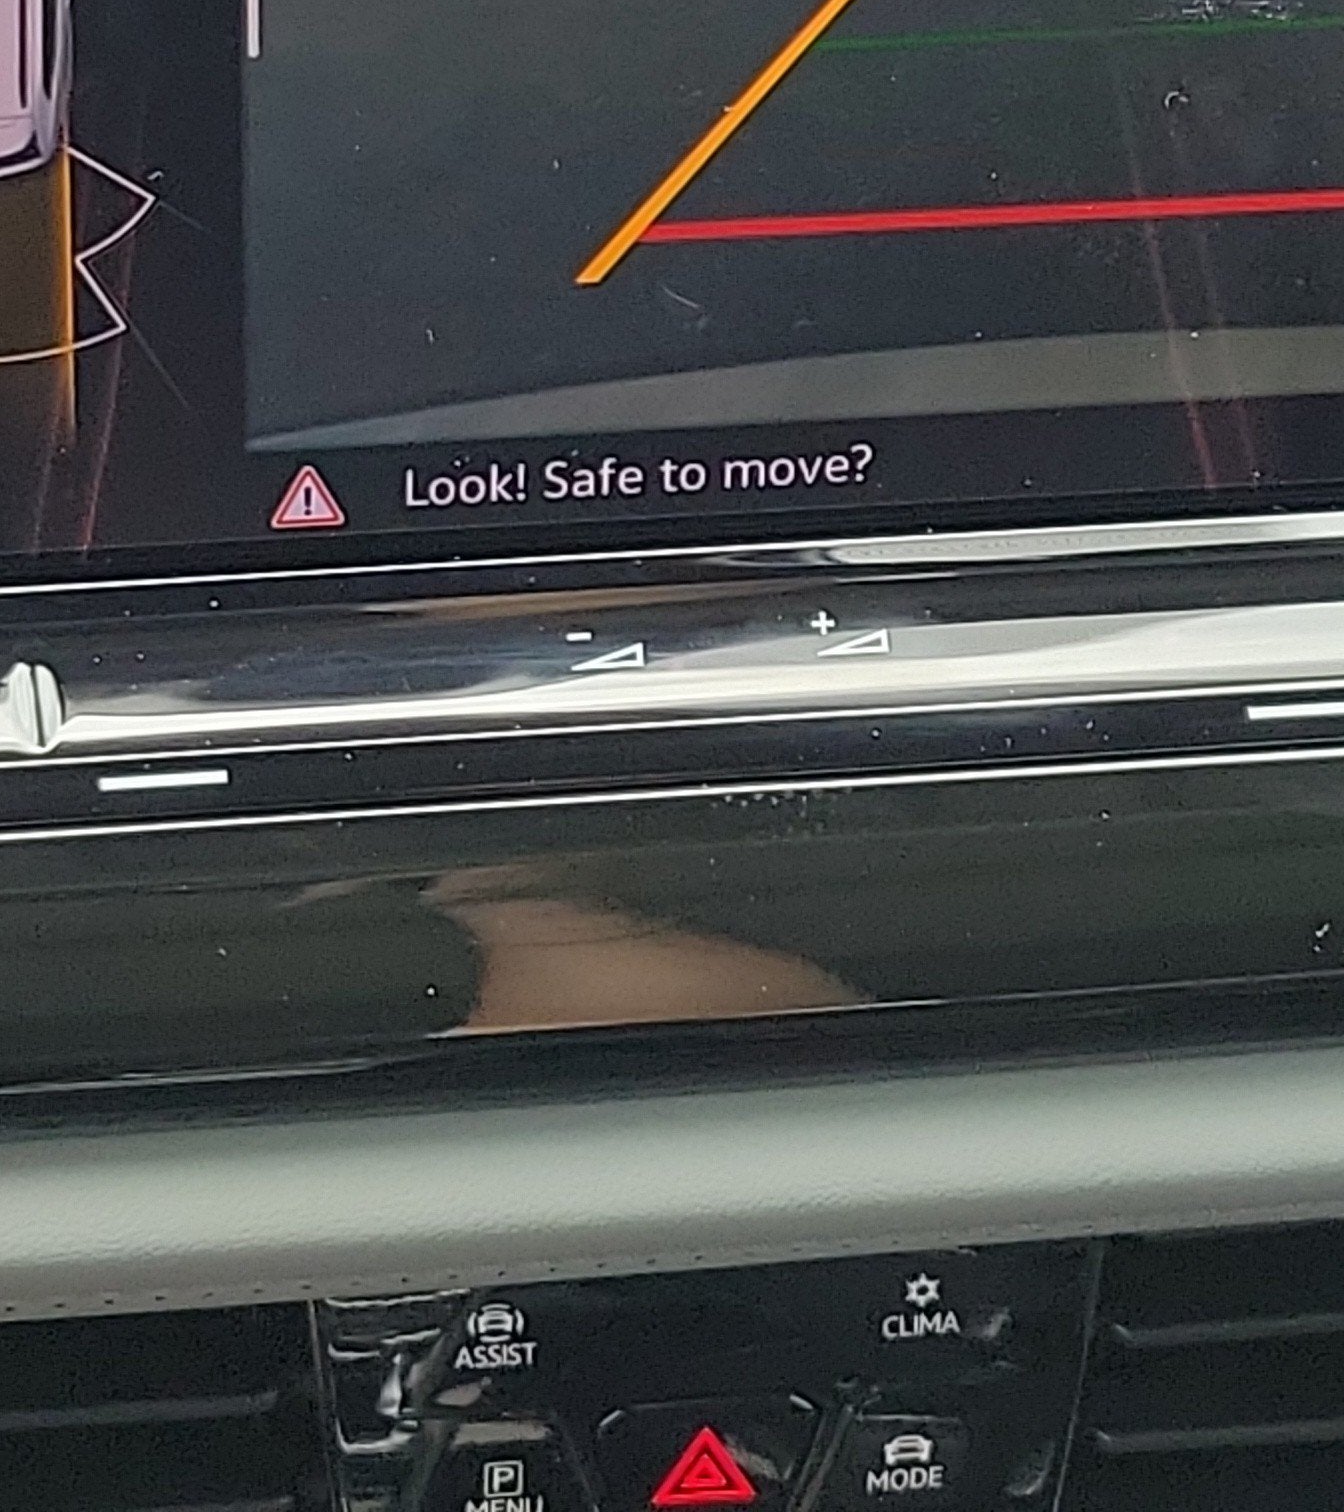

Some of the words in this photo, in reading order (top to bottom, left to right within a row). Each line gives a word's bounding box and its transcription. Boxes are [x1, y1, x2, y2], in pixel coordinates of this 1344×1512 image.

[405, 462, 527, 507] Look!
[543, 457, 643, 500] Safe
[659, 458, 707, 493] to
[723, 443, 874, 490] move?
[881, 1310, 961, 1340] CLIMA
[454, 1341, 538, 1370] ASSIST
[866, 1464, 945, 1496] MODE
